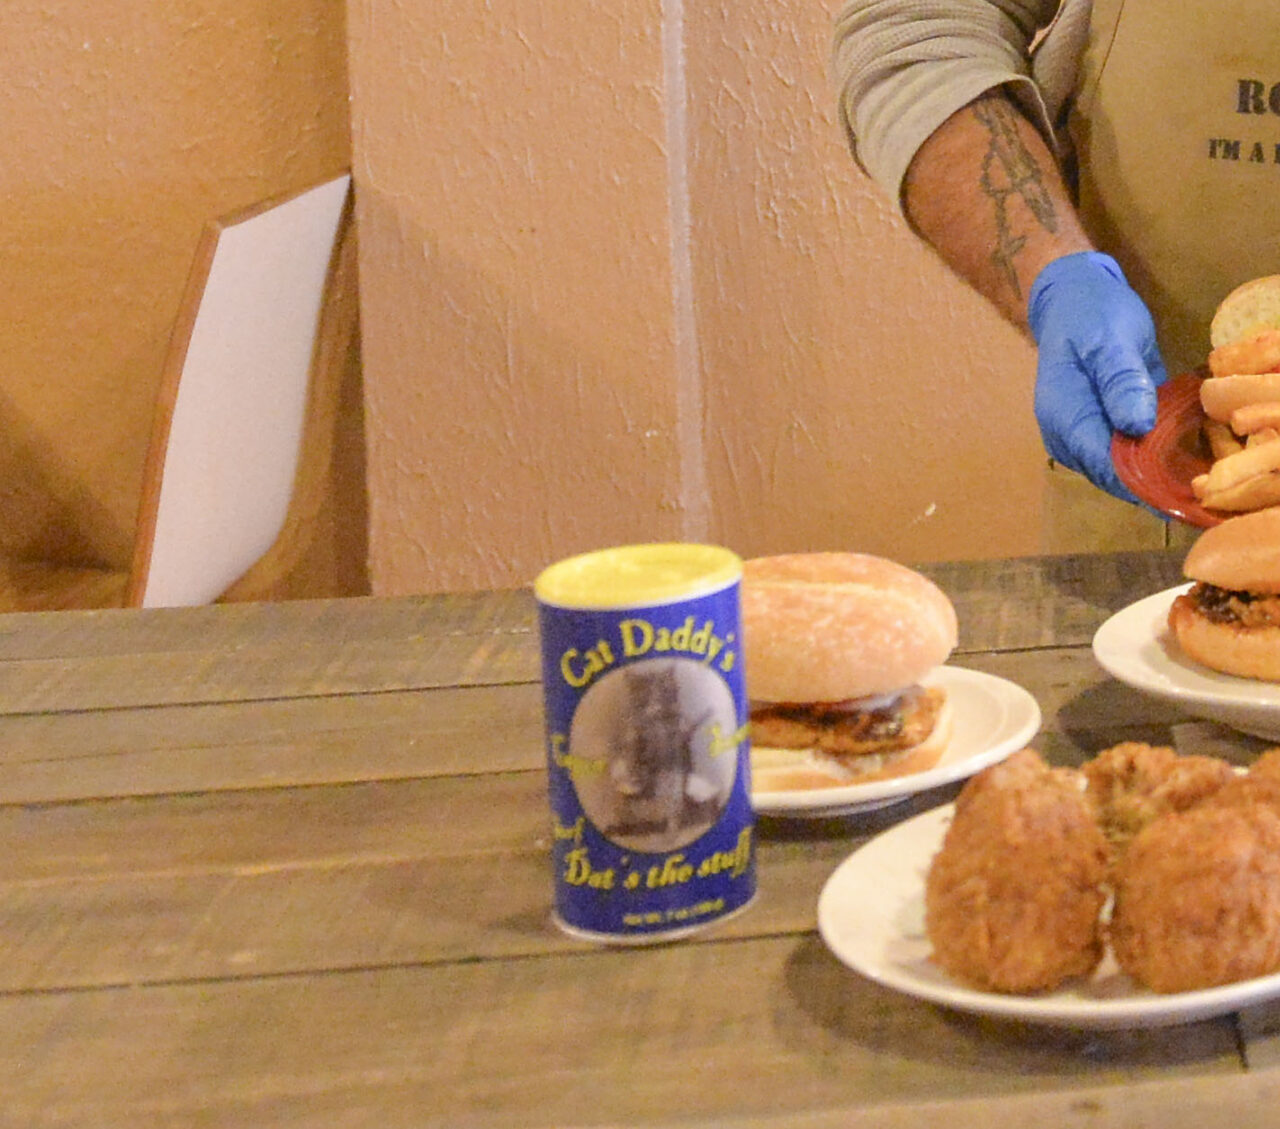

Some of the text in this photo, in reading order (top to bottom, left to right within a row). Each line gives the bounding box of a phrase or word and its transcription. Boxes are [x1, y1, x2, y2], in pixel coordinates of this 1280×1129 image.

[1208, 138, 1240, 161] I'M
[1248, 142, 1264, 163] A
[560, 615, 736, 688] Cat Daddy's
